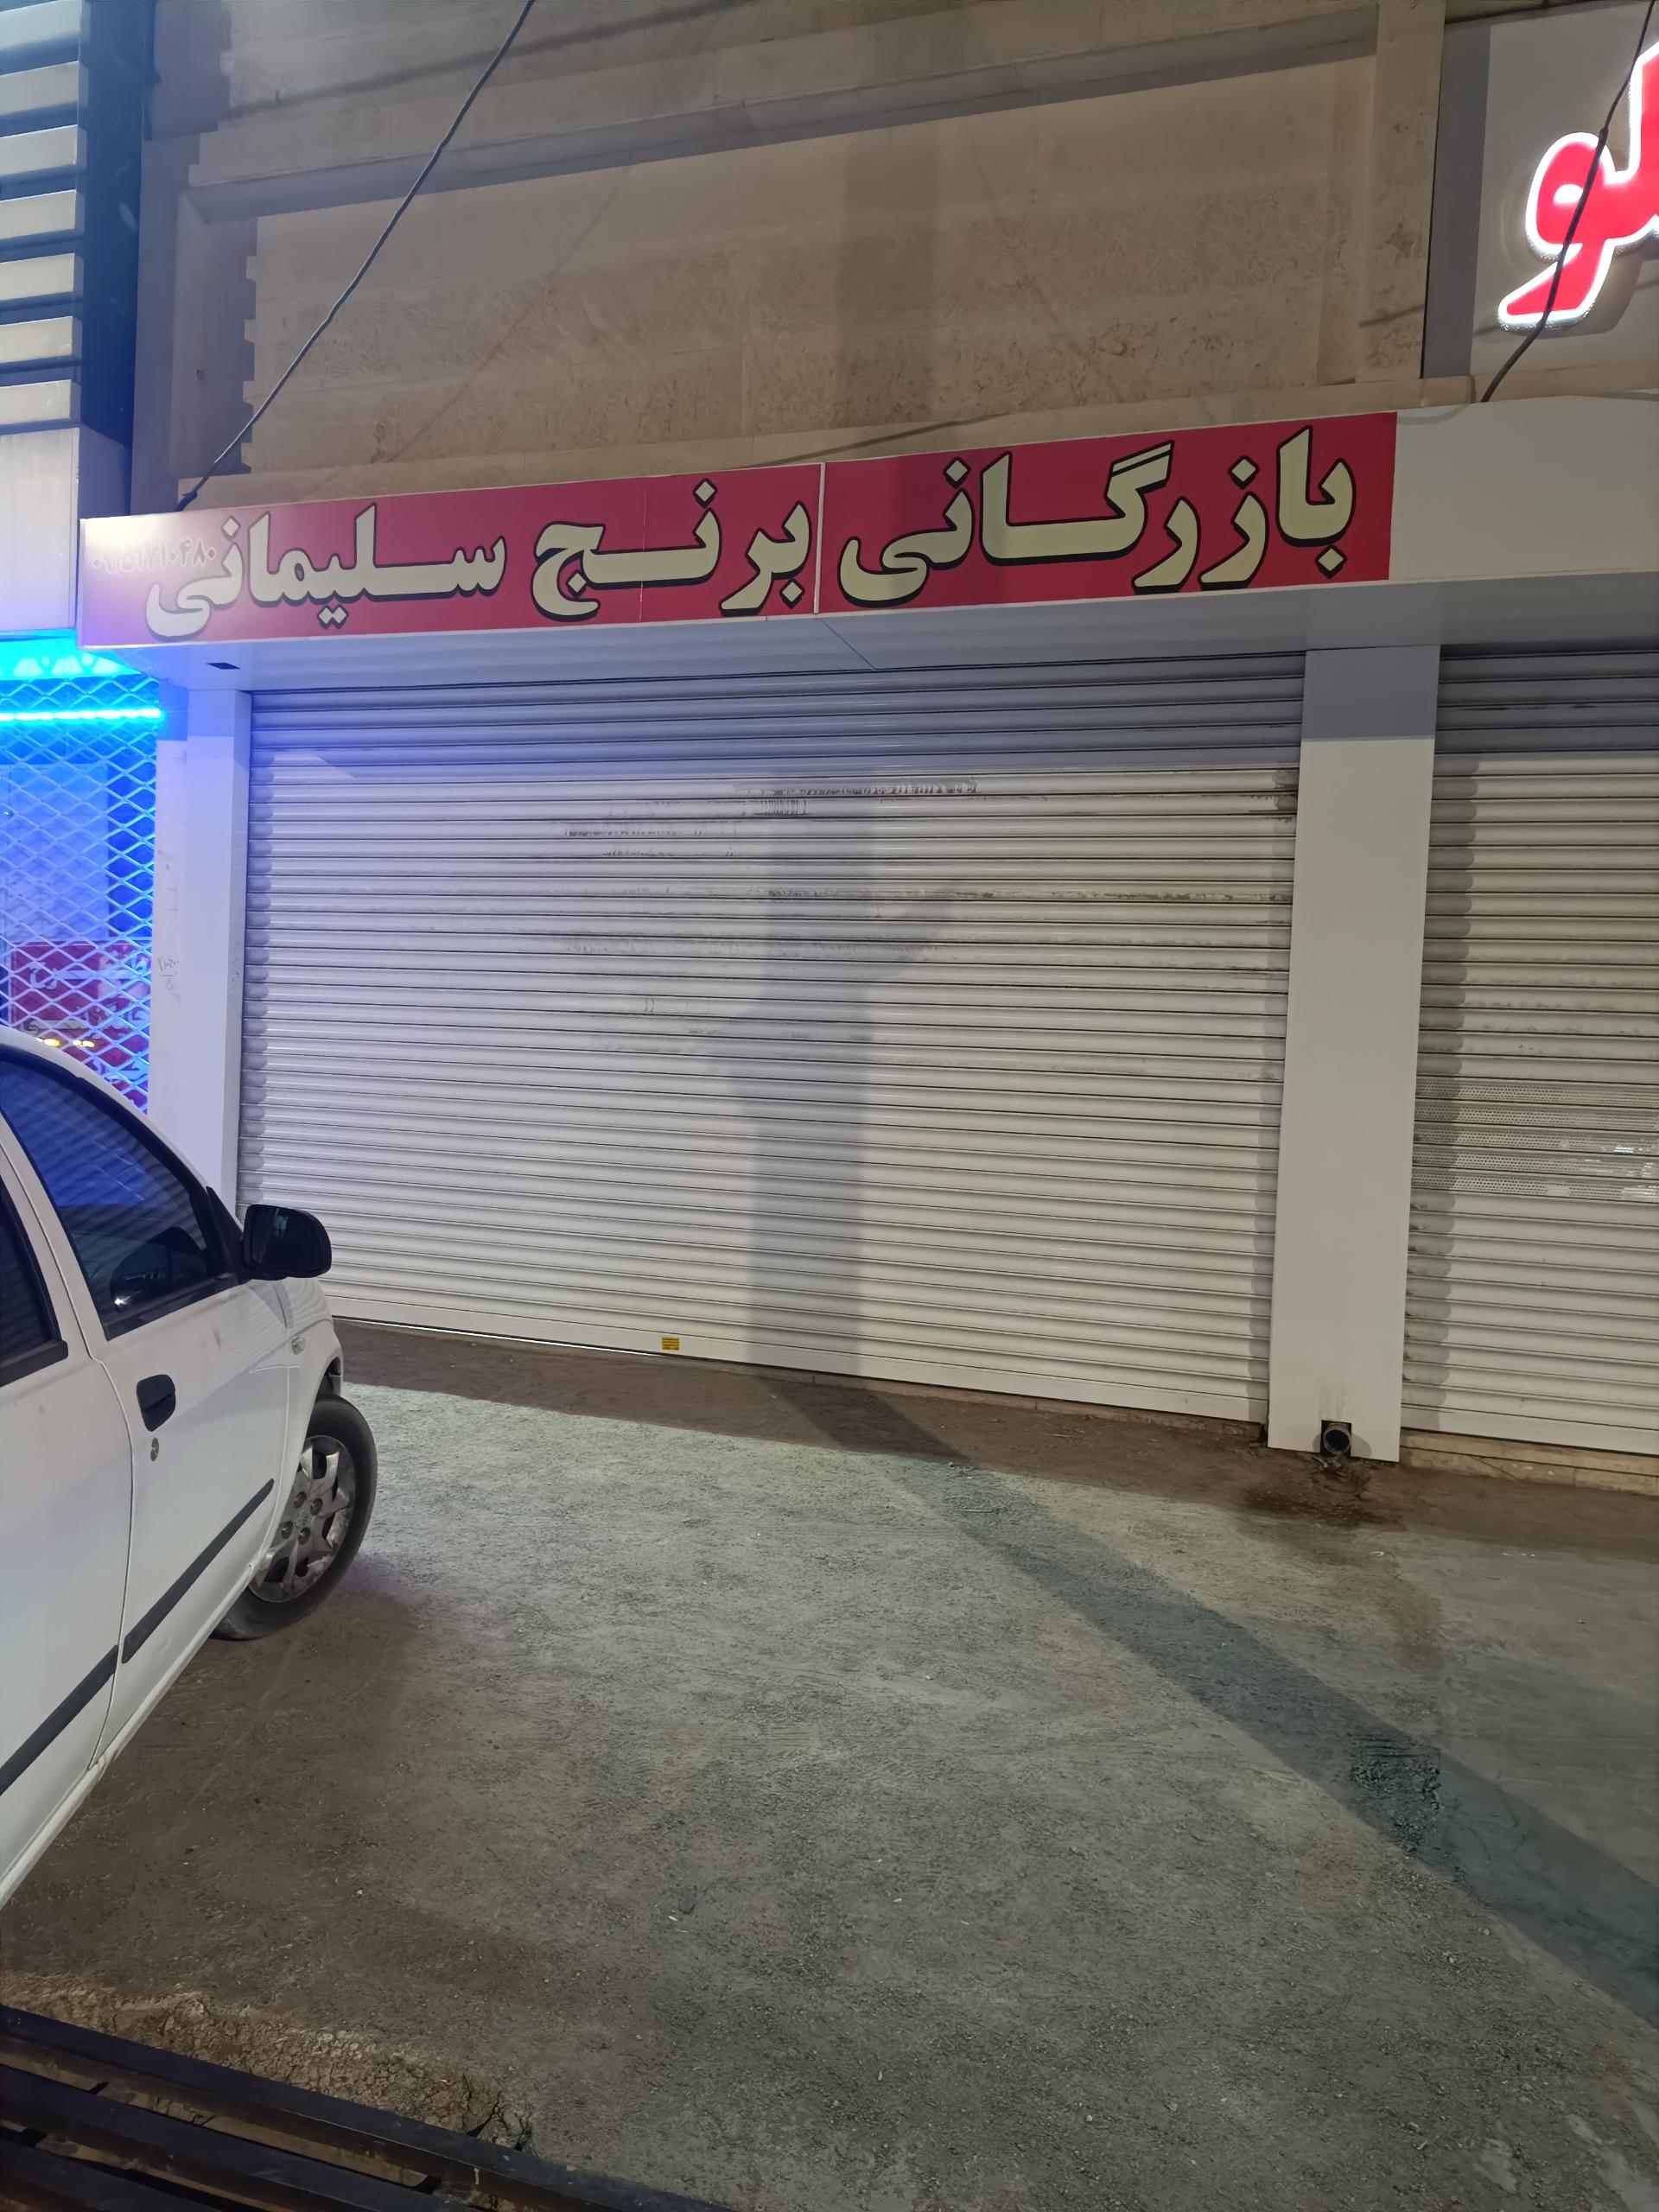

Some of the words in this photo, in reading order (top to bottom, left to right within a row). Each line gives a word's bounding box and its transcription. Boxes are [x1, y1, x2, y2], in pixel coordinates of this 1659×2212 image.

[145, 502, 506, 641] سلیمانی
[530, 479, 812, 621] برنج
[837, 425, 1357, 607] بازرگانی
